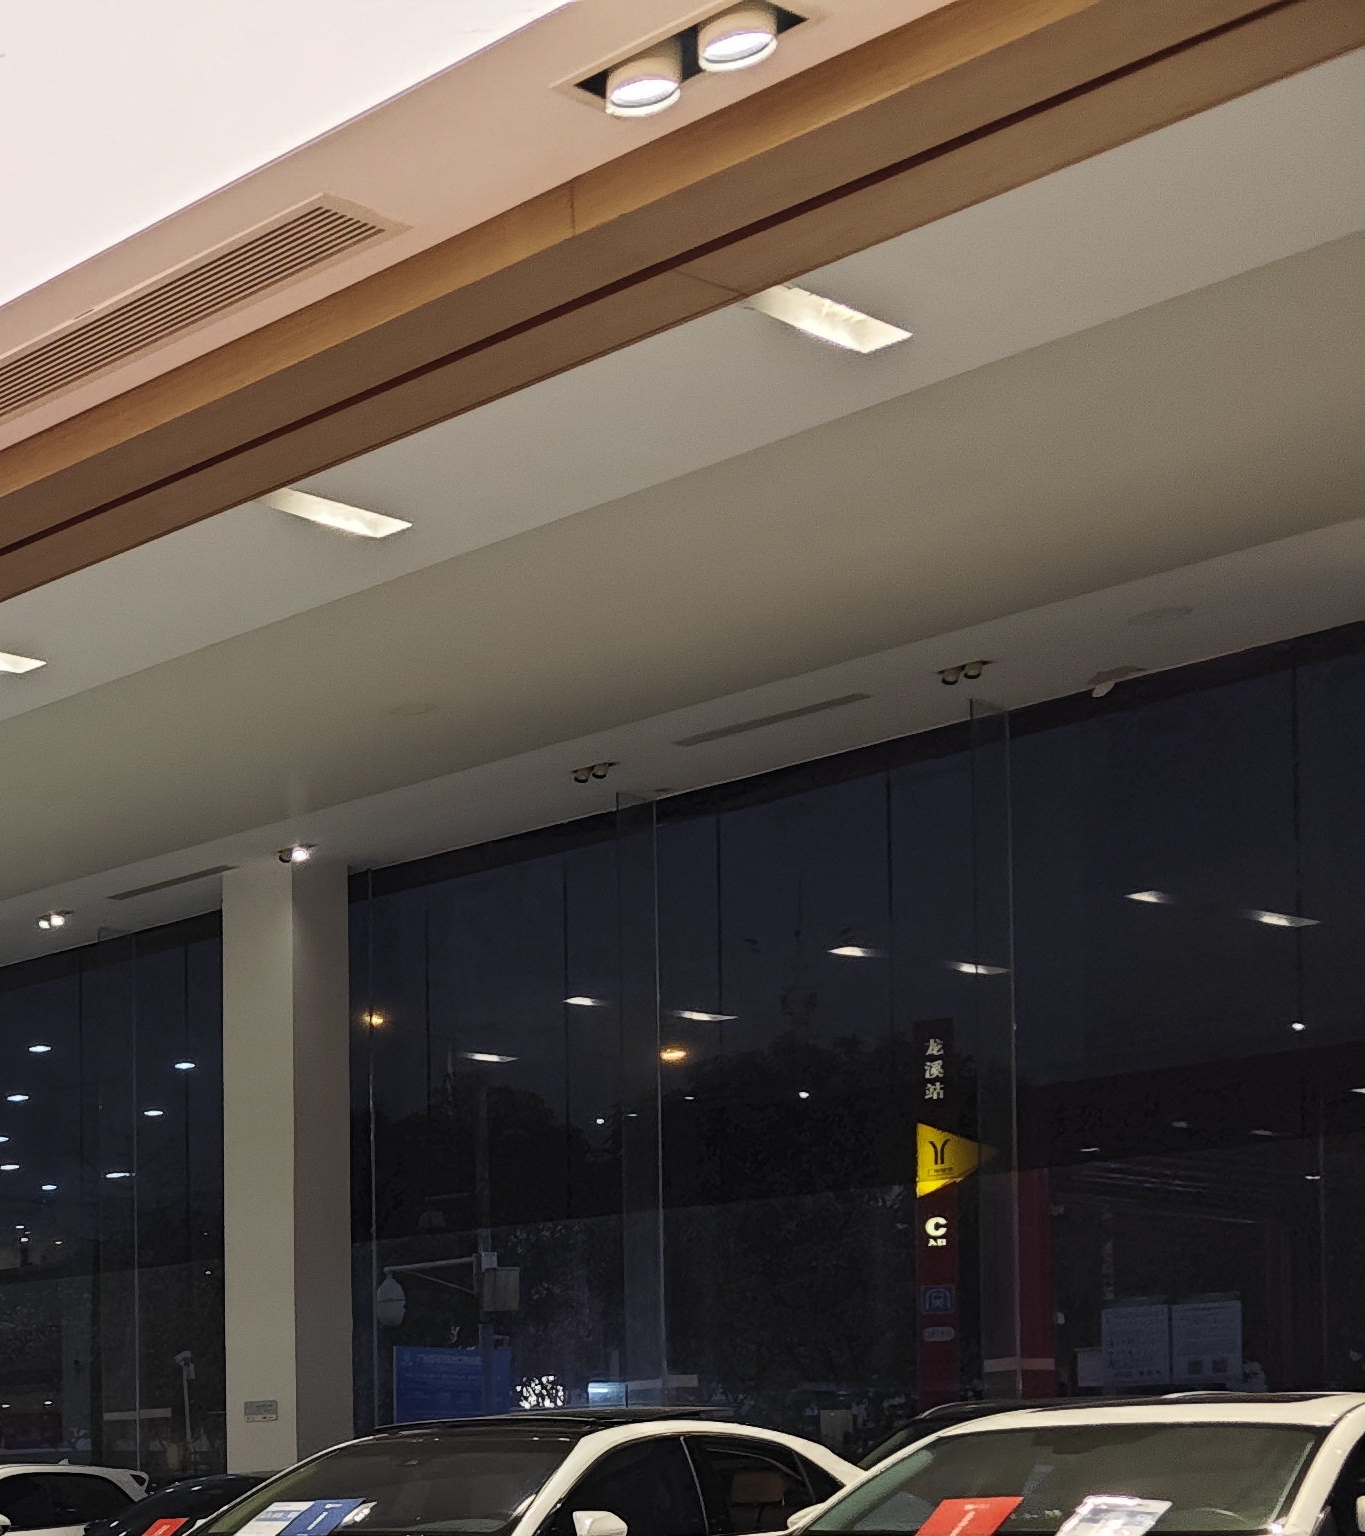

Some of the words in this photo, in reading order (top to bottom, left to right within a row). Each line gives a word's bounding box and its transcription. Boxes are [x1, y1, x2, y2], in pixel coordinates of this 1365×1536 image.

[924, 1038, 945, 1100] 龙溪站
[925, 1216, 948, 1237] C
